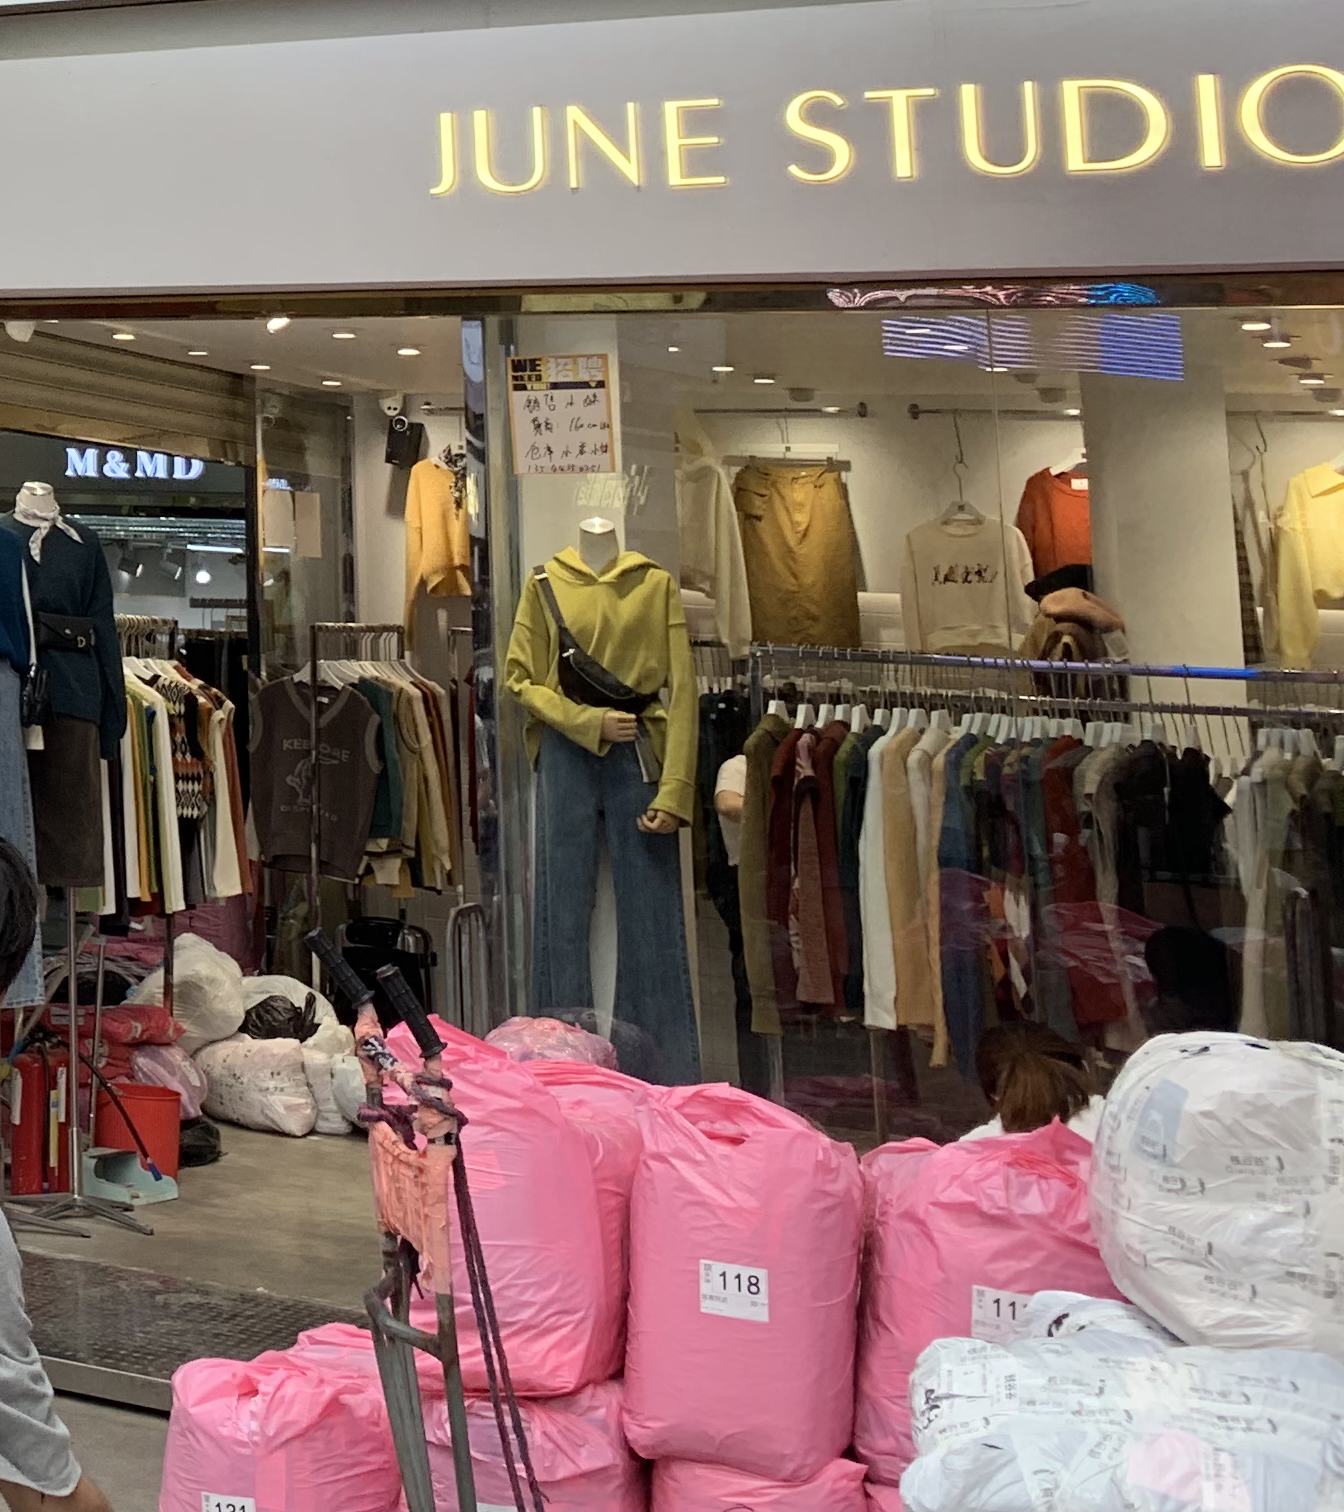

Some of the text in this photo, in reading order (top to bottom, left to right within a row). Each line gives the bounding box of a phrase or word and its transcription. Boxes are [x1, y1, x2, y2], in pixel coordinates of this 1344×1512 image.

[428, 61, 1344, 198] JUNE STUDIO
[64, 446, 205, 482] M&MD
[718, 1270, 761, 1296] 118
[992, 1297, 1030, 1321] 11
